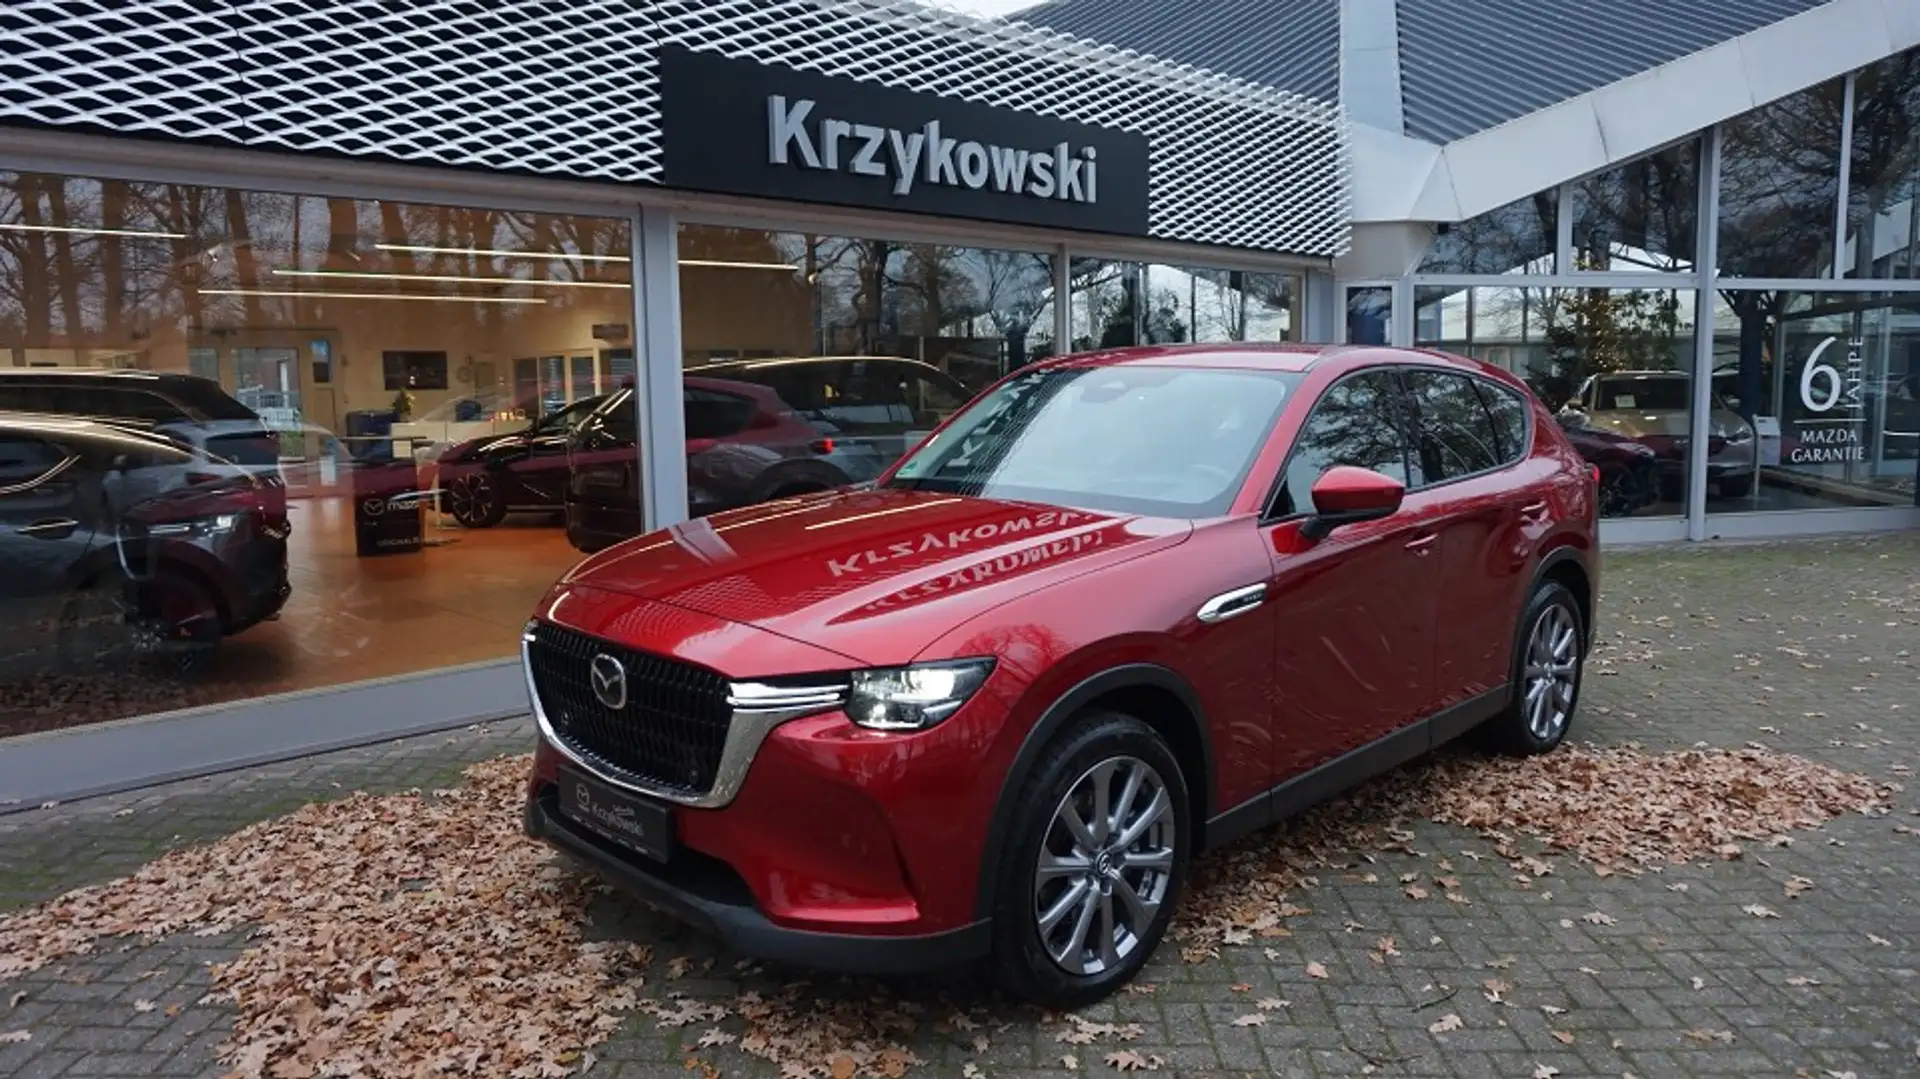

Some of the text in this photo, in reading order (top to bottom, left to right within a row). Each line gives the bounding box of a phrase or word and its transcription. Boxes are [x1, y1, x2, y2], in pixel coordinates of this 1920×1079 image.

[767, 94, 1097, 203] Krzykowski
[1800, 336, 1841, 412] 6
[1791, 447, 1865, 463] GARANTIE
[1801, 428, 1858, 444] MAZDA
